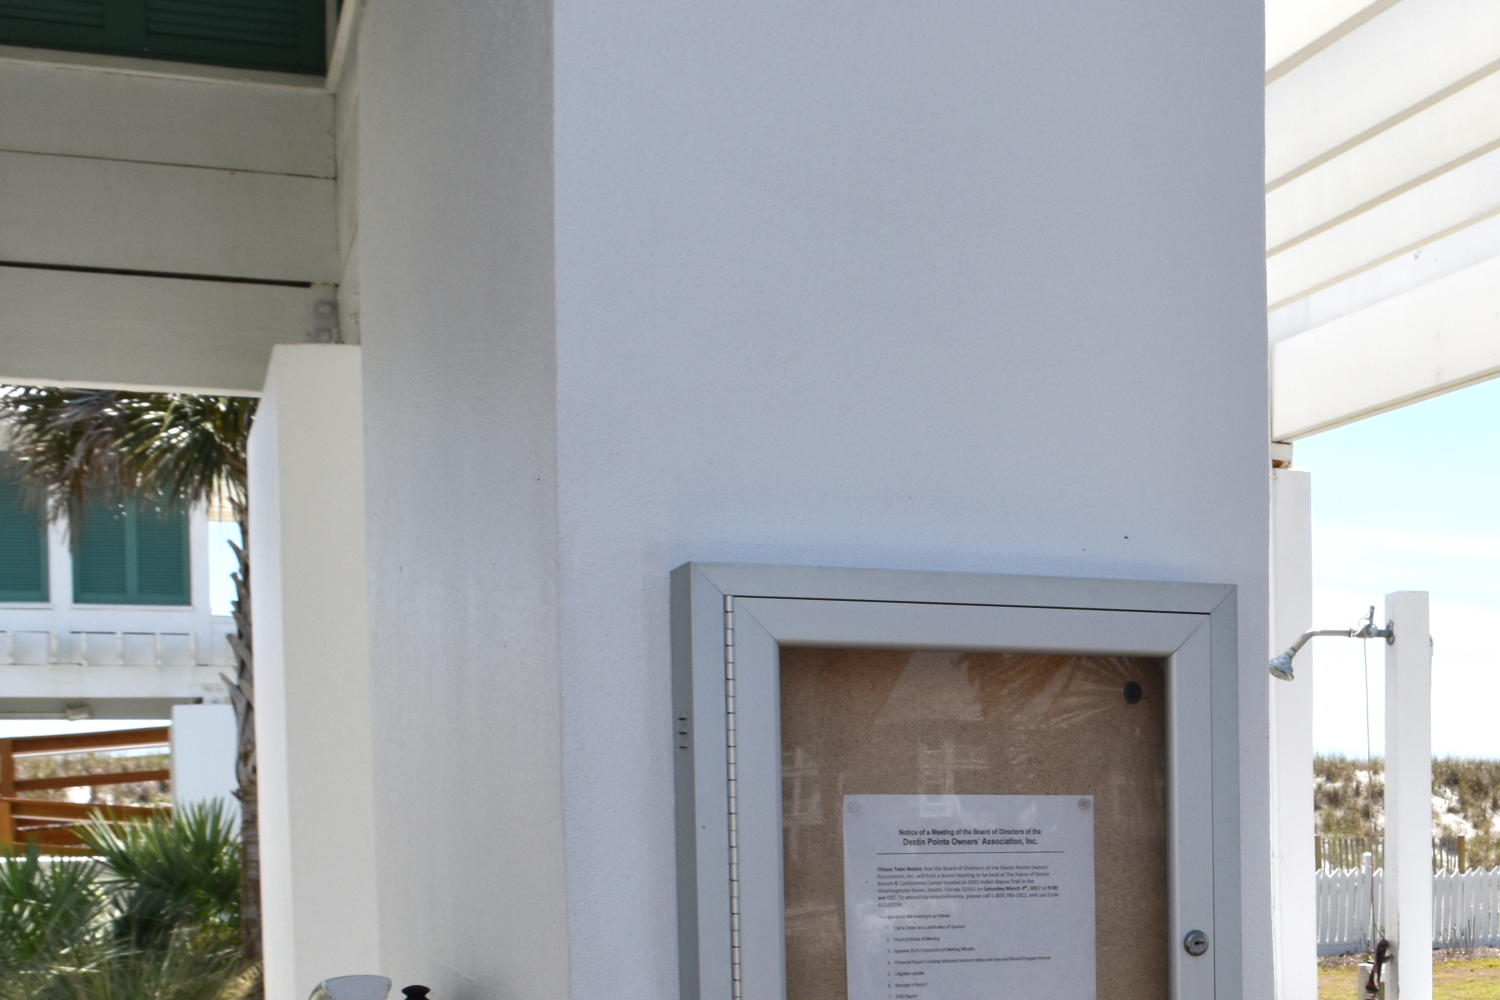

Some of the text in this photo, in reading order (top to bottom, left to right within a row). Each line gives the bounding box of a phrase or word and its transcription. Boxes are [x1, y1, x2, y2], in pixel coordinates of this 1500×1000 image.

[931, 829, 954, 837] Meeting
[903, 838, 926, 846] Destin
[927, 838, 951, 846] Pointe
[982, 837, 1025, 846] Association,
